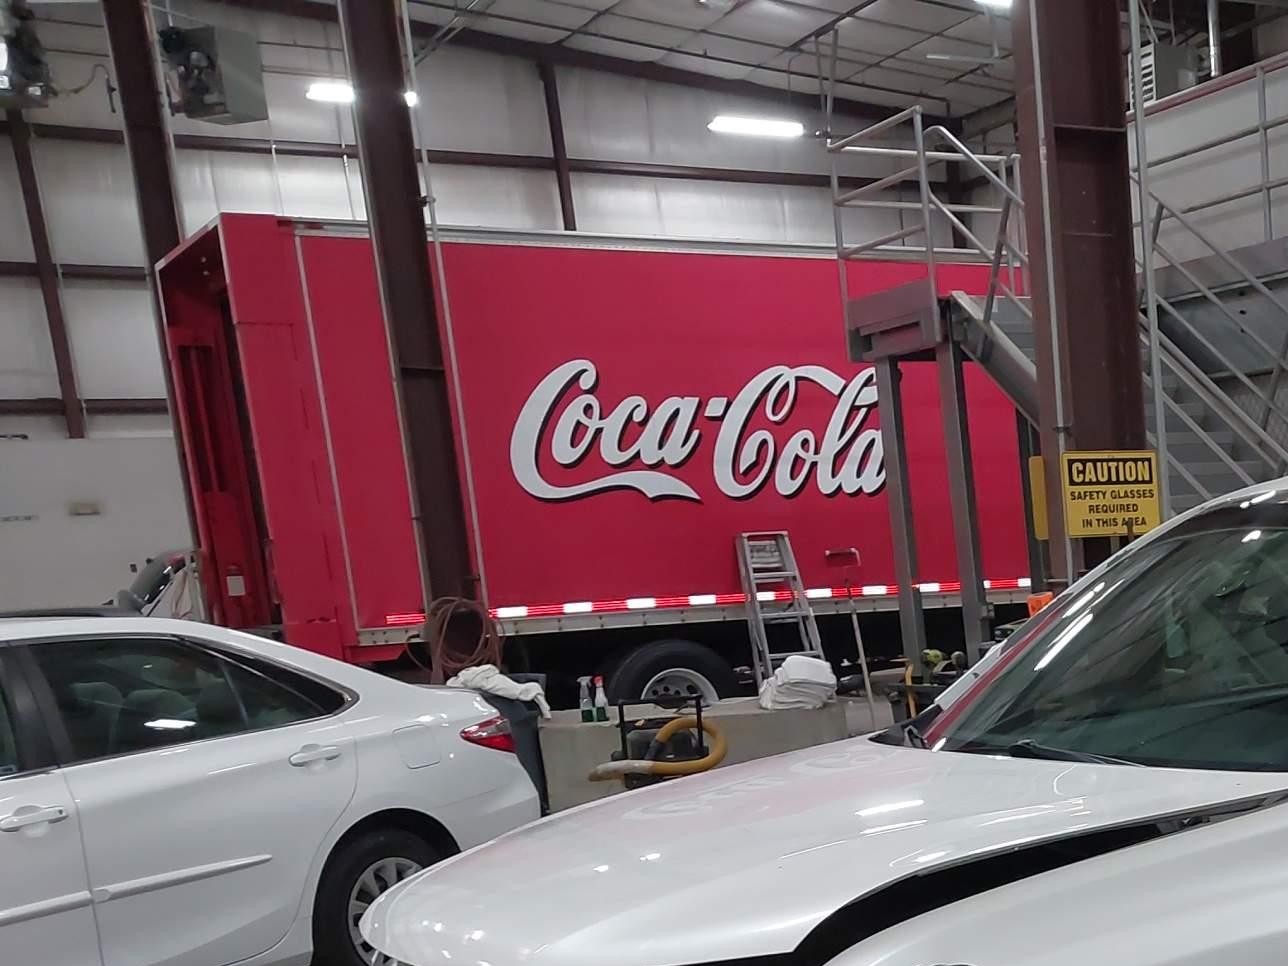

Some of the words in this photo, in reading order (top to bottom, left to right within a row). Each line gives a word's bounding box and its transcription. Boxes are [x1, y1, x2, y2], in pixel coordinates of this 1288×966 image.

[510, 359, 887, 500] Coca-Cola
[1071, 461, 1150, 482] CAUTION
[1070, 490, 1107, 500] SAFETY
[1110, 489, 1154, 500] GLASSES
[1088, 503, 1139, 514] REQUIRED
[1082, 518, 1093, 528] IN
[1095, 518, 1118, 528] THIS
